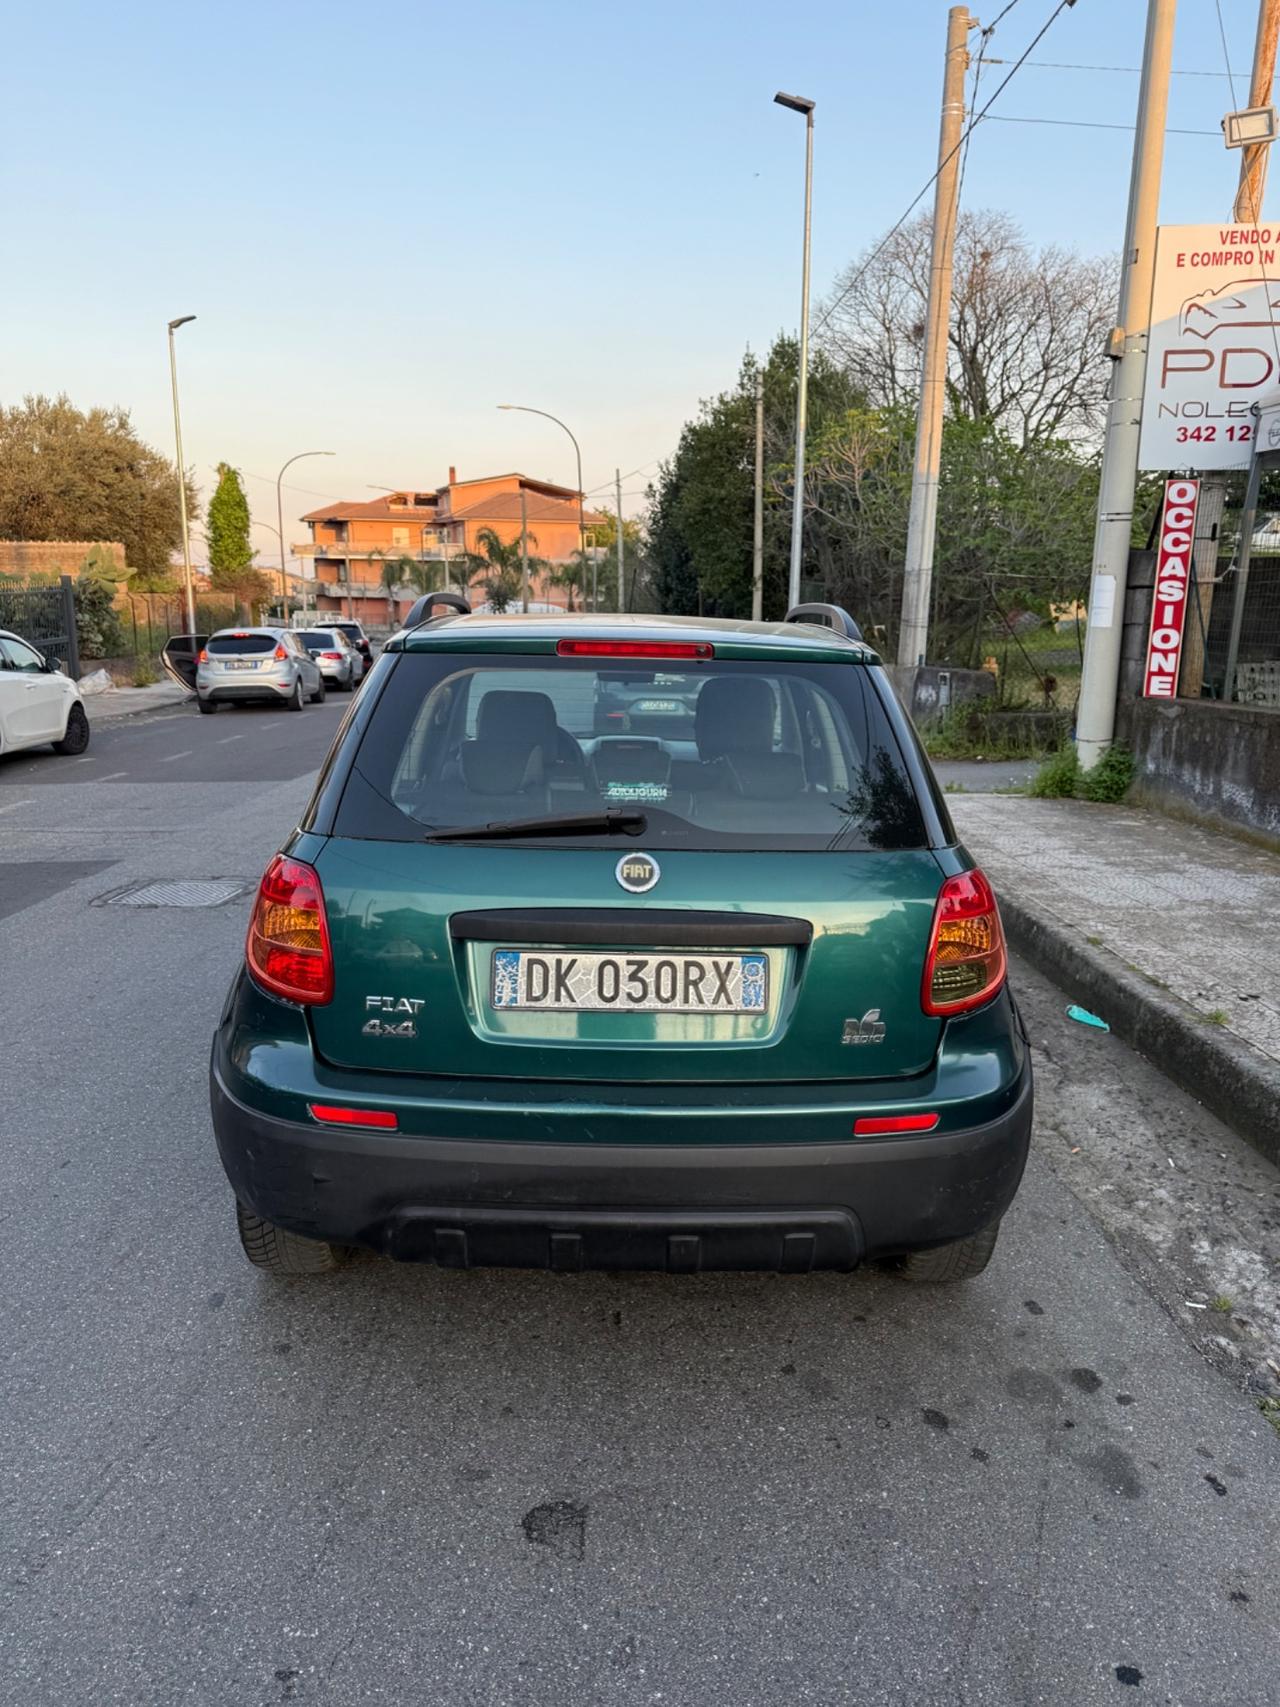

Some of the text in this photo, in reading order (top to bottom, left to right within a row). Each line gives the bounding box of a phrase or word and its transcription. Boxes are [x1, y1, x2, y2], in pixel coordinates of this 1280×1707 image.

[1220, 229, 1271, 245] VENDO
[1176, 249, 1274, 267] E COMPRO IN
[1161, 348, 1280, 389] PD
[1176, 426, 1217, 443] 342
[1225, 424, 1256, 442] 12
[1149, 482, 1197, 696] OCCASIONE
[623, 864, 652, 878] FIAT
[525, 957, 735, 1005] DK 030RX
[365, 996, 426, 1014] FIAT
[362, 1019, 417, 1038] 4x4
